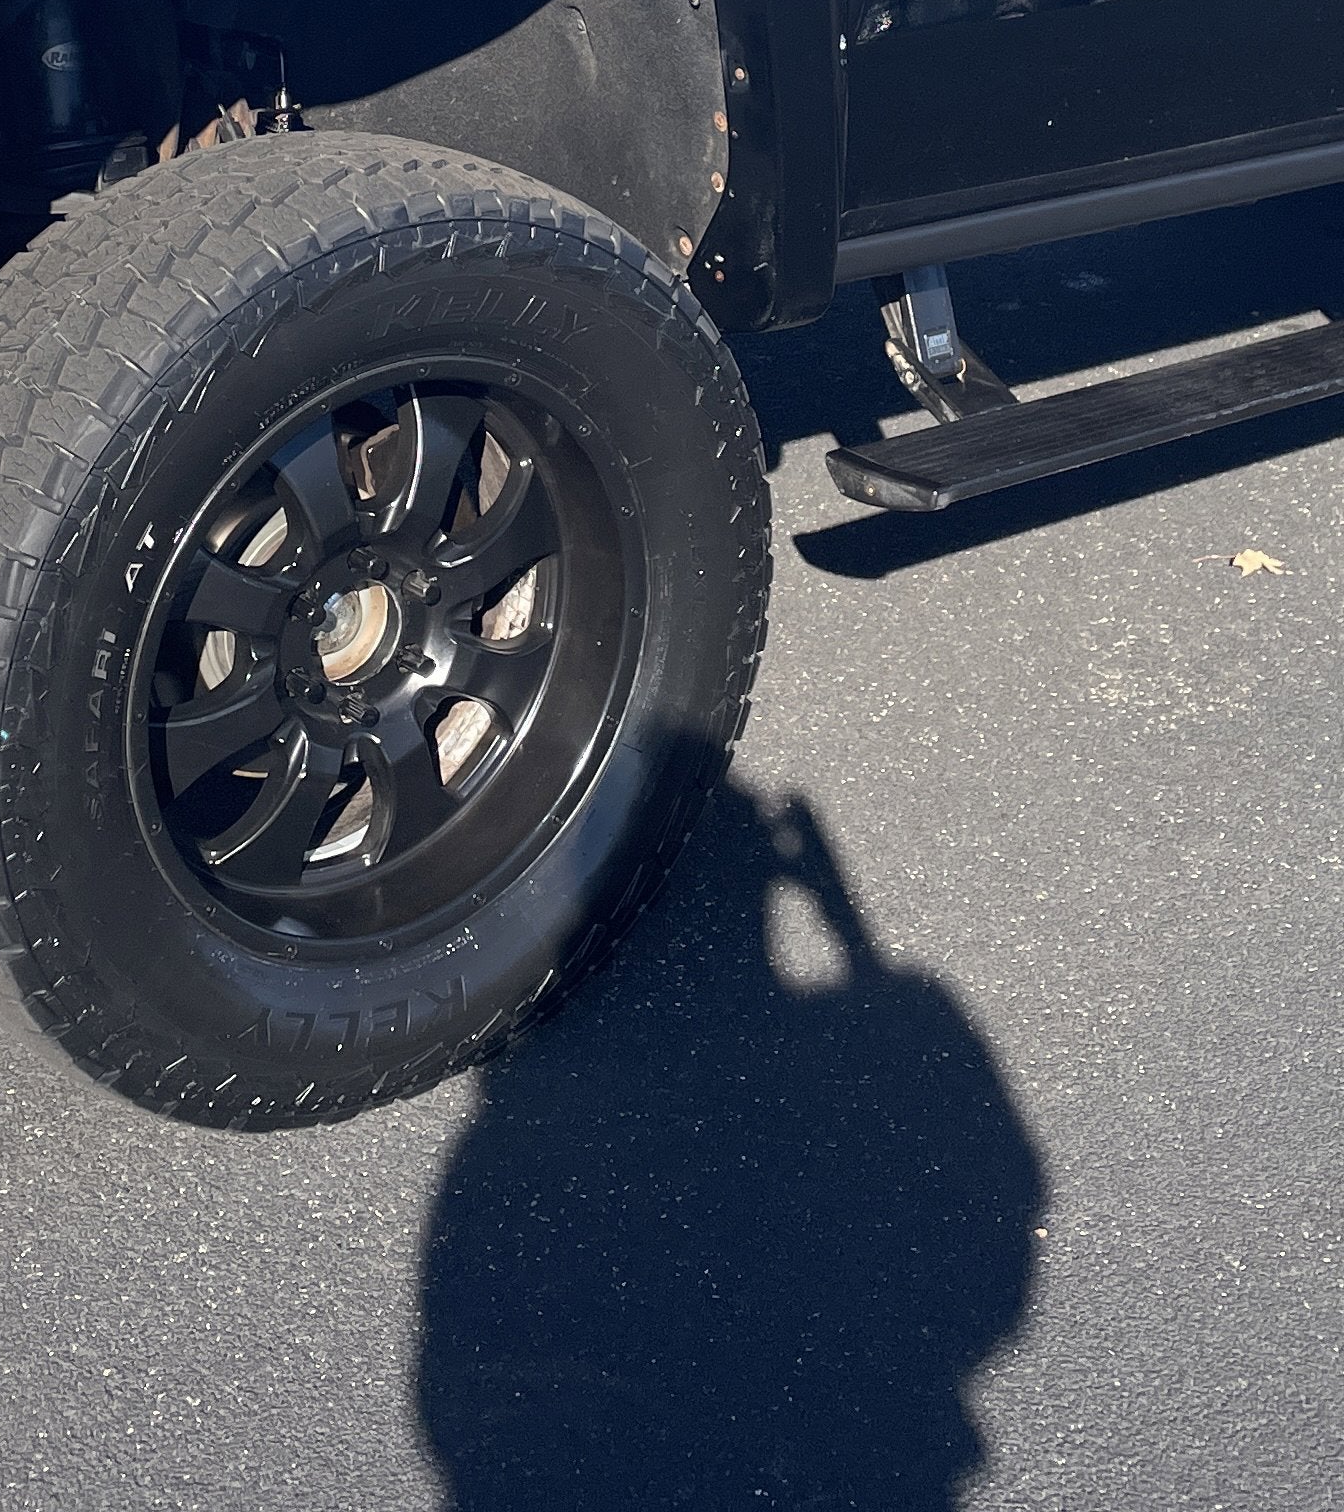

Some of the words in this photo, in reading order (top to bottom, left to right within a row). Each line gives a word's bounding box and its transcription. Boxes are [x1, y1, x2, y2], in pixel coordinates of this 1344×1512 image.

[368, 286, 596, 345] KELLY
[82, 627, 119, 831] SAFARI
[123, 520, 157, 595] AT
[227, 974, 468, 1051] KELLY
